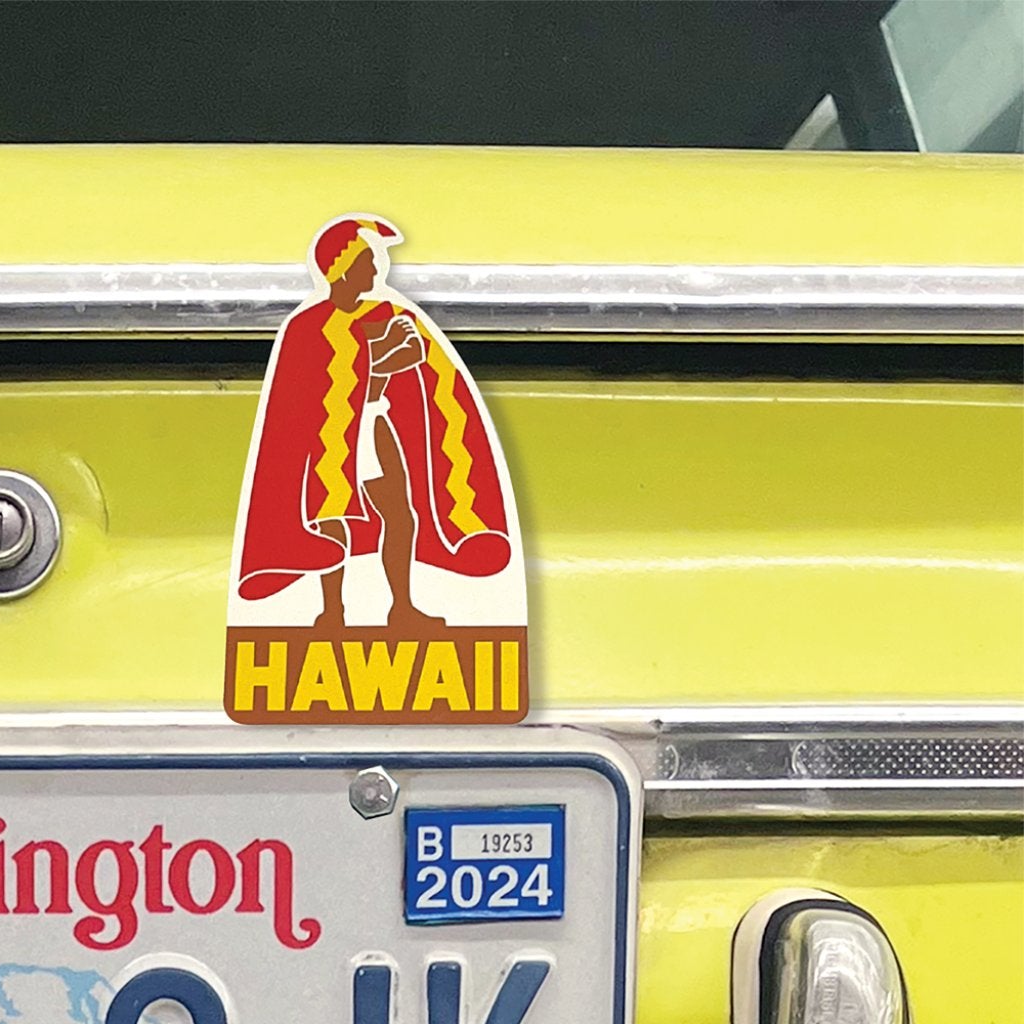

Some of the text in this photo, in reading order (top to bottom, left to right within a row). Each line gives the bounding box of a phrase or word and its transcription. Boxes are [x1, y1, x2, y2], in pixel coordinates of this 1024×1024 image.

[234, 641, 519, 711] HAWAII
[417, 826, 533, 862] B 19253
[416, 864, 553, 908] 2024
